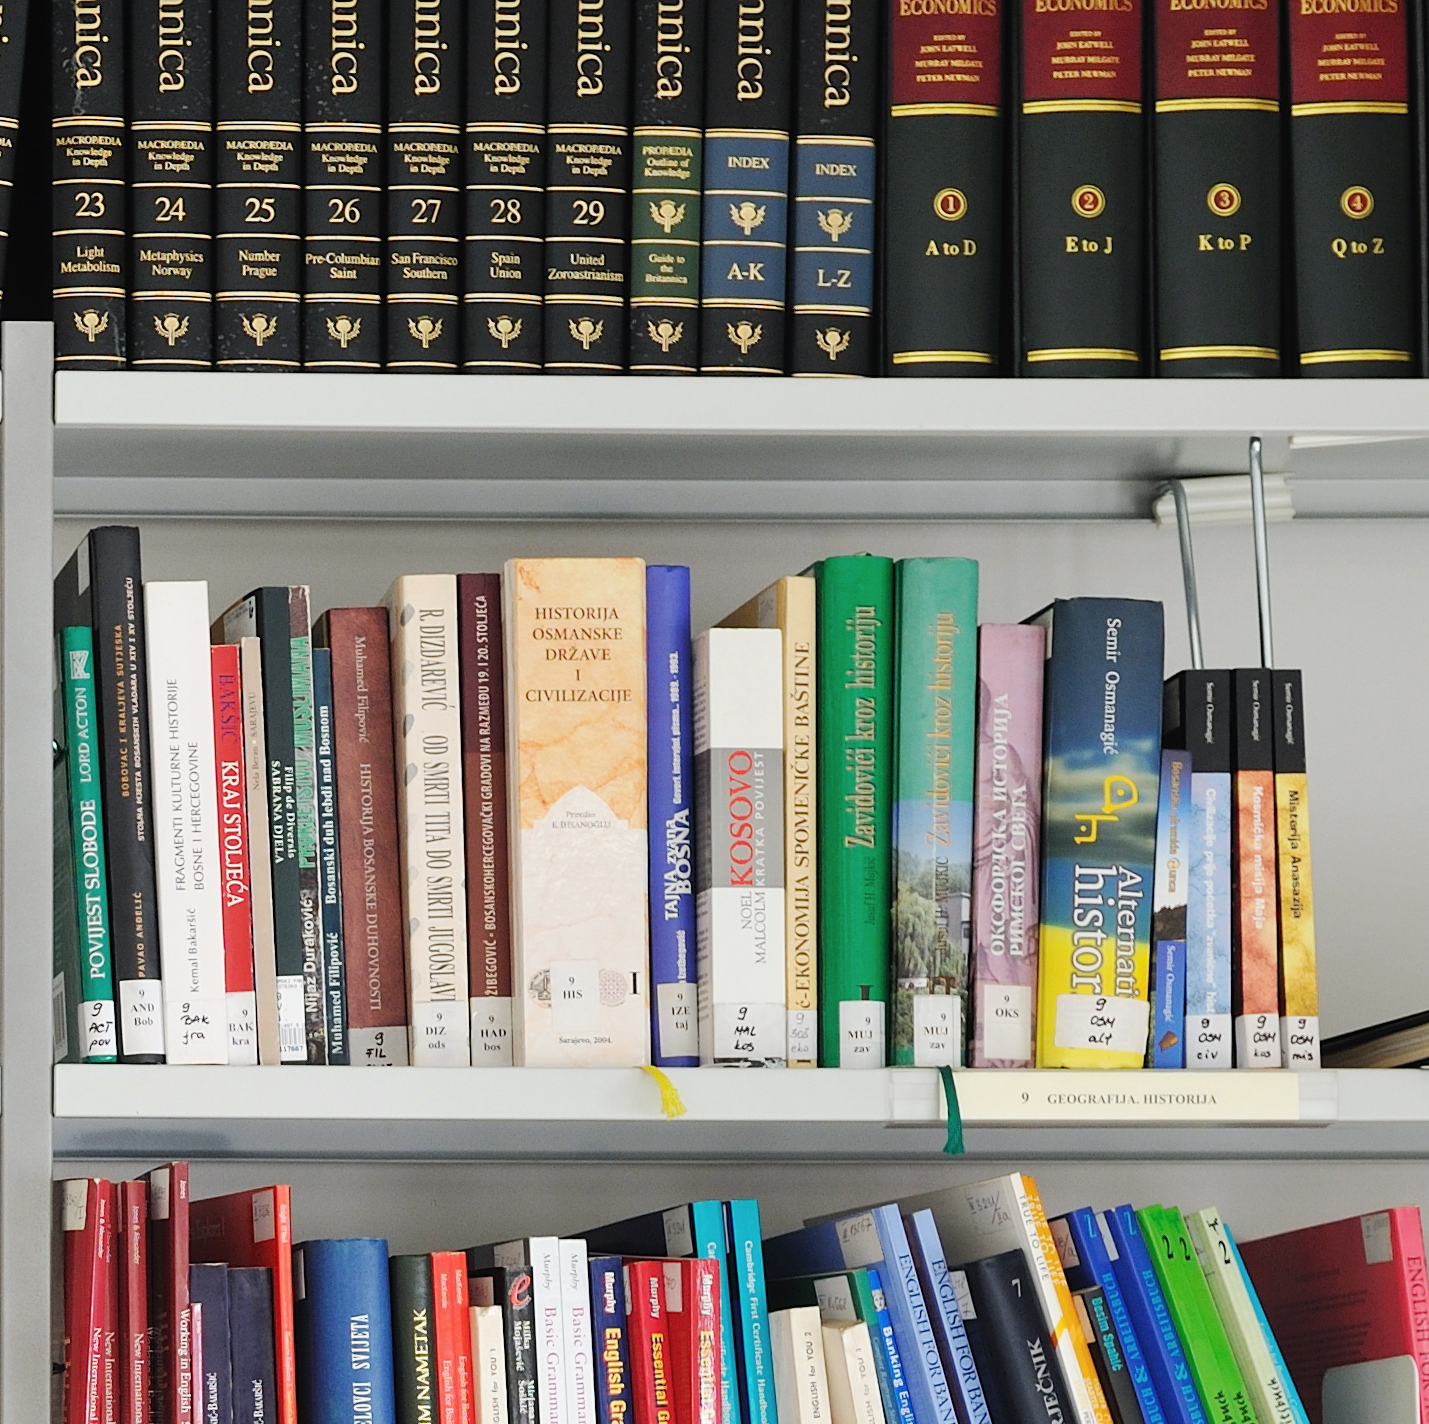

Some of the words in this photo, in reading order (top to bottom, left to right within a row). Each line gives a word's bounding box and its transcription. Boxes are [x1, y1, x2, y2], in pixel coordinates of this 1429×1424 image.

[727, 156, 770, 169] INDEX
[75, 192, 105, 217] 23
[245, 198, 275, 223] 25
[572, 200, 605, 226] 29
[1198, 235, 1215, 251] K
[1218, 235, 1235, 251] to
[1240, 235, 1252, 251] P
[76, 246, 104, 261] Light
[239, 249, 281, 263] Number
[570, 253, 605, 266] United
[61, 261, 120, 274] Metabolism
[242, 264, 277, 279] Prague
[548, 268, 624, 283] Zoroastrianism
[727, 263, 766, 280] A-K
[817, 270, 851, 288] L-Z
[535, 607, 620, 621] HISTORIJA
[533, 627, 623, 640] OSMANSKE
[1105, 617, 1121, 663] Semir
[545, 648, 613, 662] DRŽAVE
[526, 690, 632, 702] CIVILIZACIJE
[1102, 671, 1120, 755] Osmanagić
[221, 760, 240, 808] KRAJ
[728, 750, 753, 887] KOSOVO
[1288, 790, 1302, 851] Misterija
[80, 799, 102, 893] SLOBODE
[223, 813, 247, 907] STOLJEĆA
[1289, 855, 1304, 919] Anasazija
[86, 900, 106, 980] POVIJEST
[1021, 1092, 1029, 1104] 9
[1143, 1093, 1218, 1105] HISTORIJA
[928, 1258, 973, 1343] ENGLISH
[953, 1346, 979, 1383] FOR
[349, 1313, 371, 1370] SVIJETA
